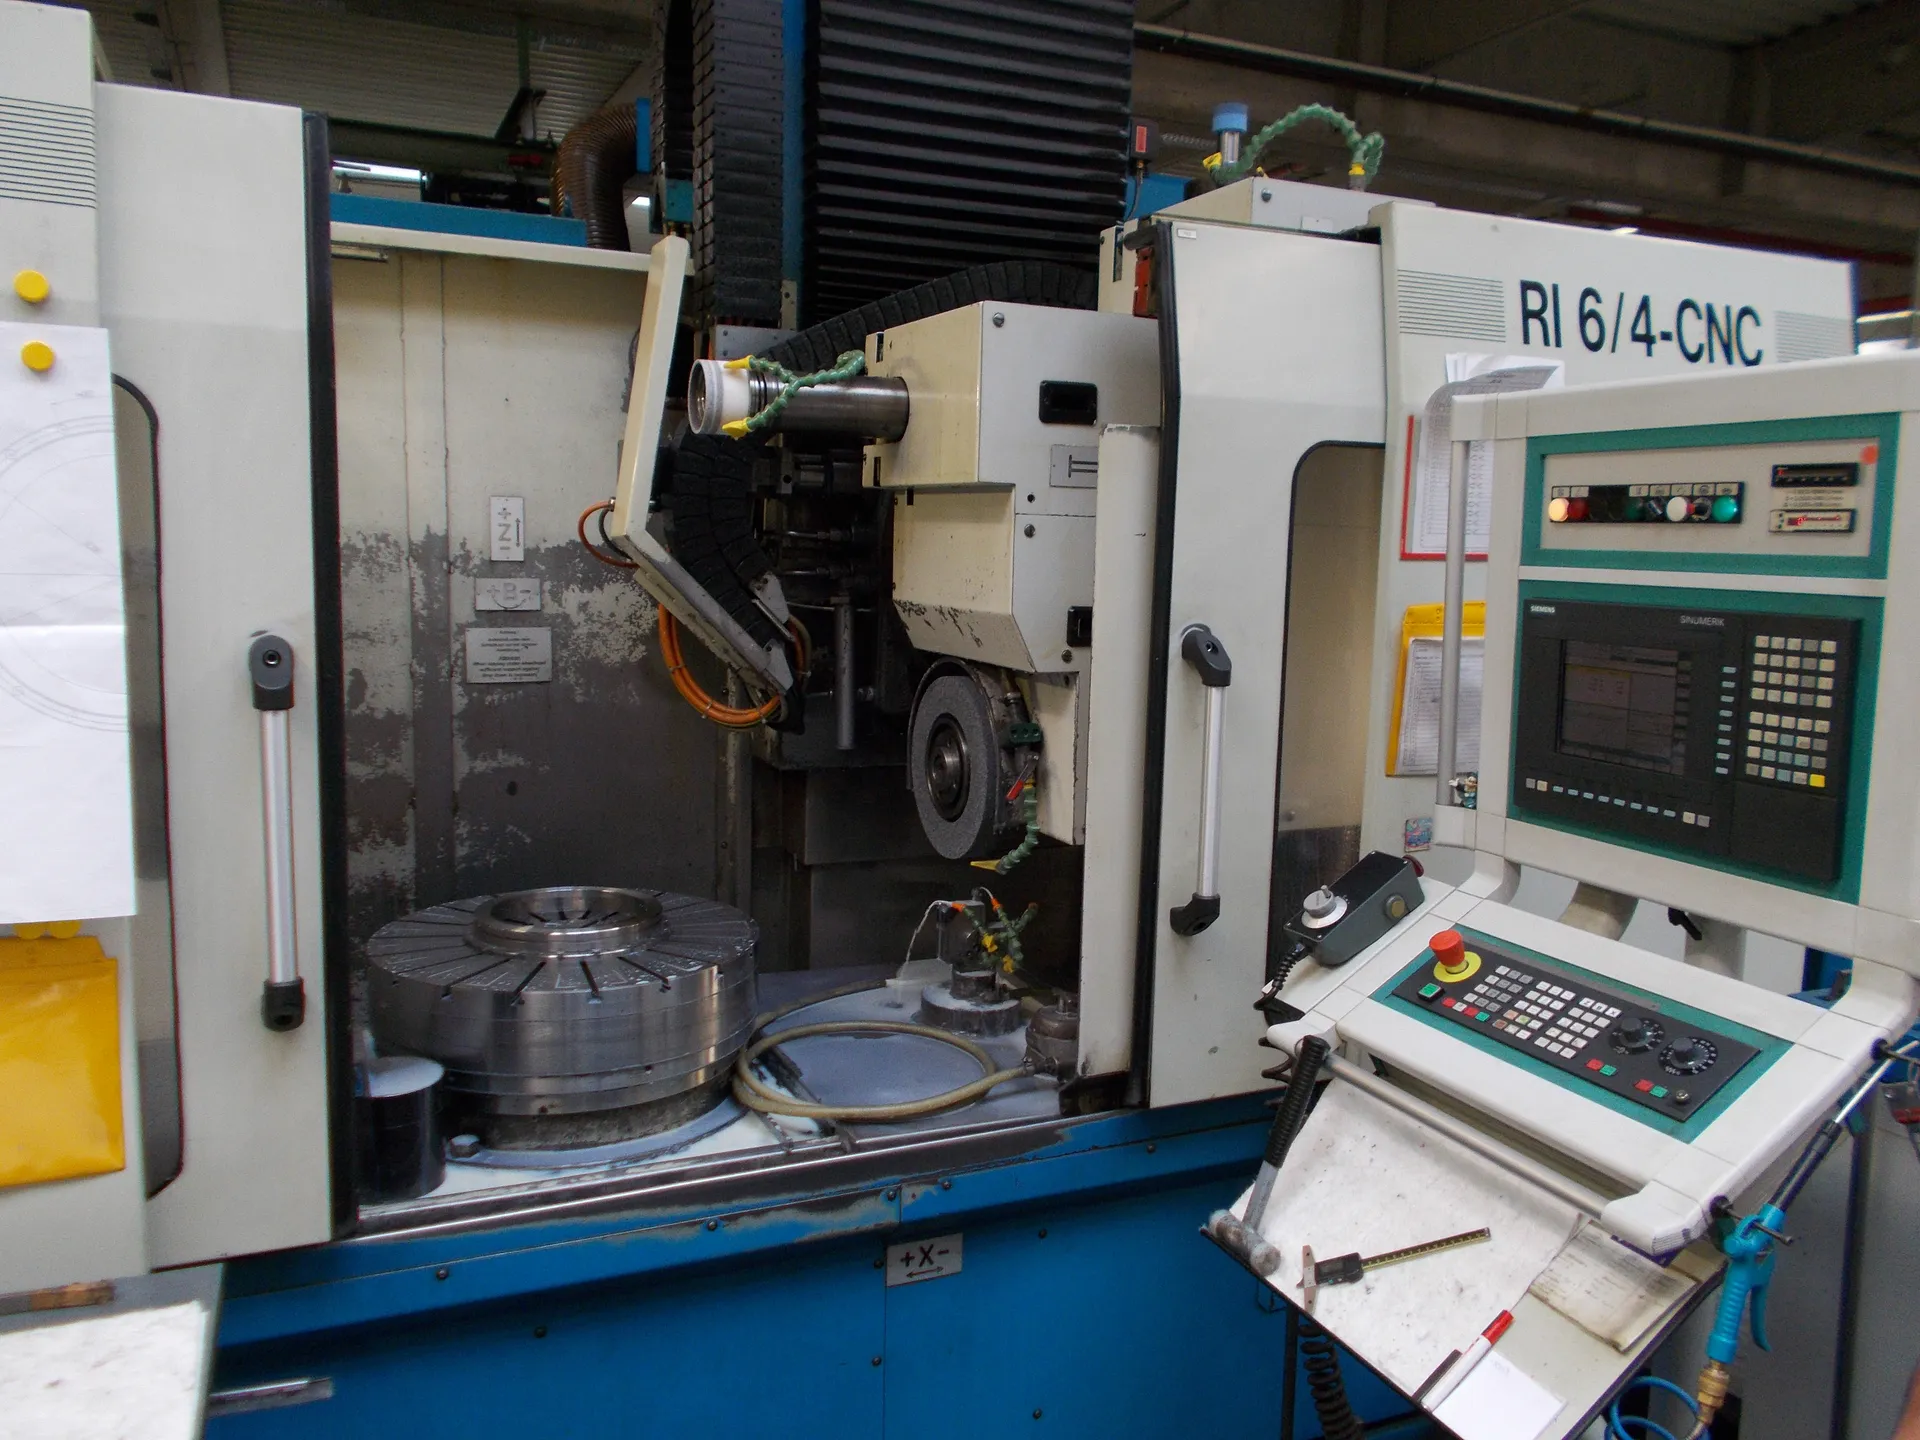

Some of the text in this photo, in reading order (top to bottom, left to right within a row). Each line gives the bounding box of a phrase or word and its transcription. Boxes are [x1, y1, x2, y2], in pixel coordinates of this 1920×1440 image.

[1519, 279, 1763, 368] RI 6/4-CNC
[1530, 605, 1556, 613] SIEMENS
[1680, 615, 1725, 627] SINUMERIK
